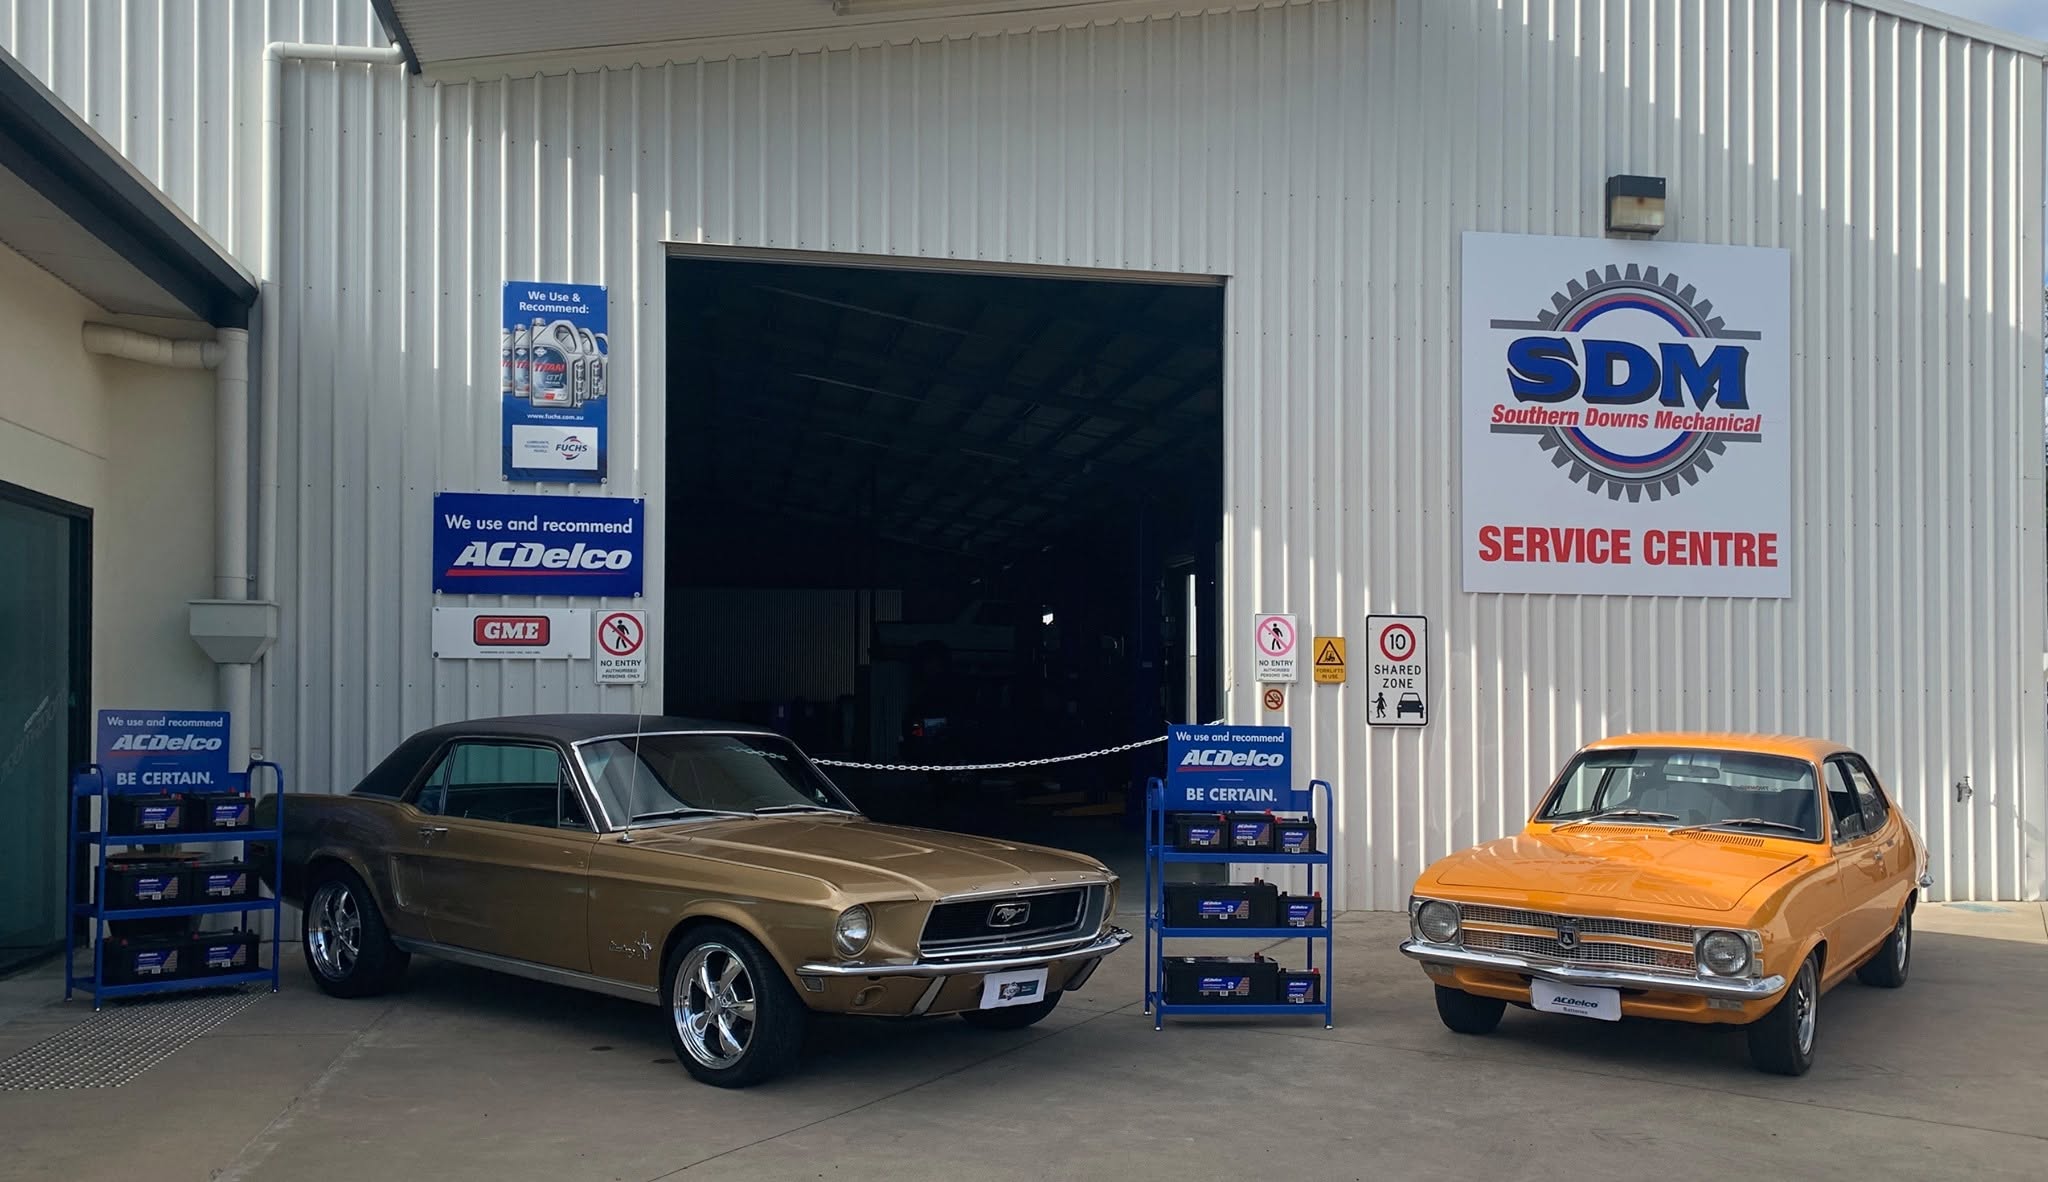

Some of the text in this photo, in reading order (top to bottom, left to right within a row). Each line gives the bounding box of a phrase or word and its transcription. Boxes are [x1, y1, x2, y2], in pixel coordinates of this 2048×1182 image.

[528, 291, 581, 302] We Use &
[520, 302, 590, 314] Recommend:
[1506, 336, 1750, 412] SDM
[1490, 404, 1762, 433] Southern Downs Mechanical
[556, 444, 588, 452] FUCHS
[445, 514, 632, 533] We use and recommend
[1478, 525, 1778, 568] SERVICE CENTRE
[453, 541, 633, 570] ACDelco
[484, 622, 540, 640] GME
[1390, 634, 1406, 650] 10
[1374, 664, 1422, 675] SHARED
[1382, 678, 1414, 689] ZONE
[107, 716, 223, 728] We use and recommend
[112, 734, 222, 751] ACDelco
[1176, 731, 1284, 742] We use and recommend
[1180, 749, 1284, 767] ACDelco
[117, 772, 214, 785] BE CERTAIN.
[1186, 788, 1277, 802] BE CERTAIN.
[1553, 996, 1598, 1009] ACDelco
